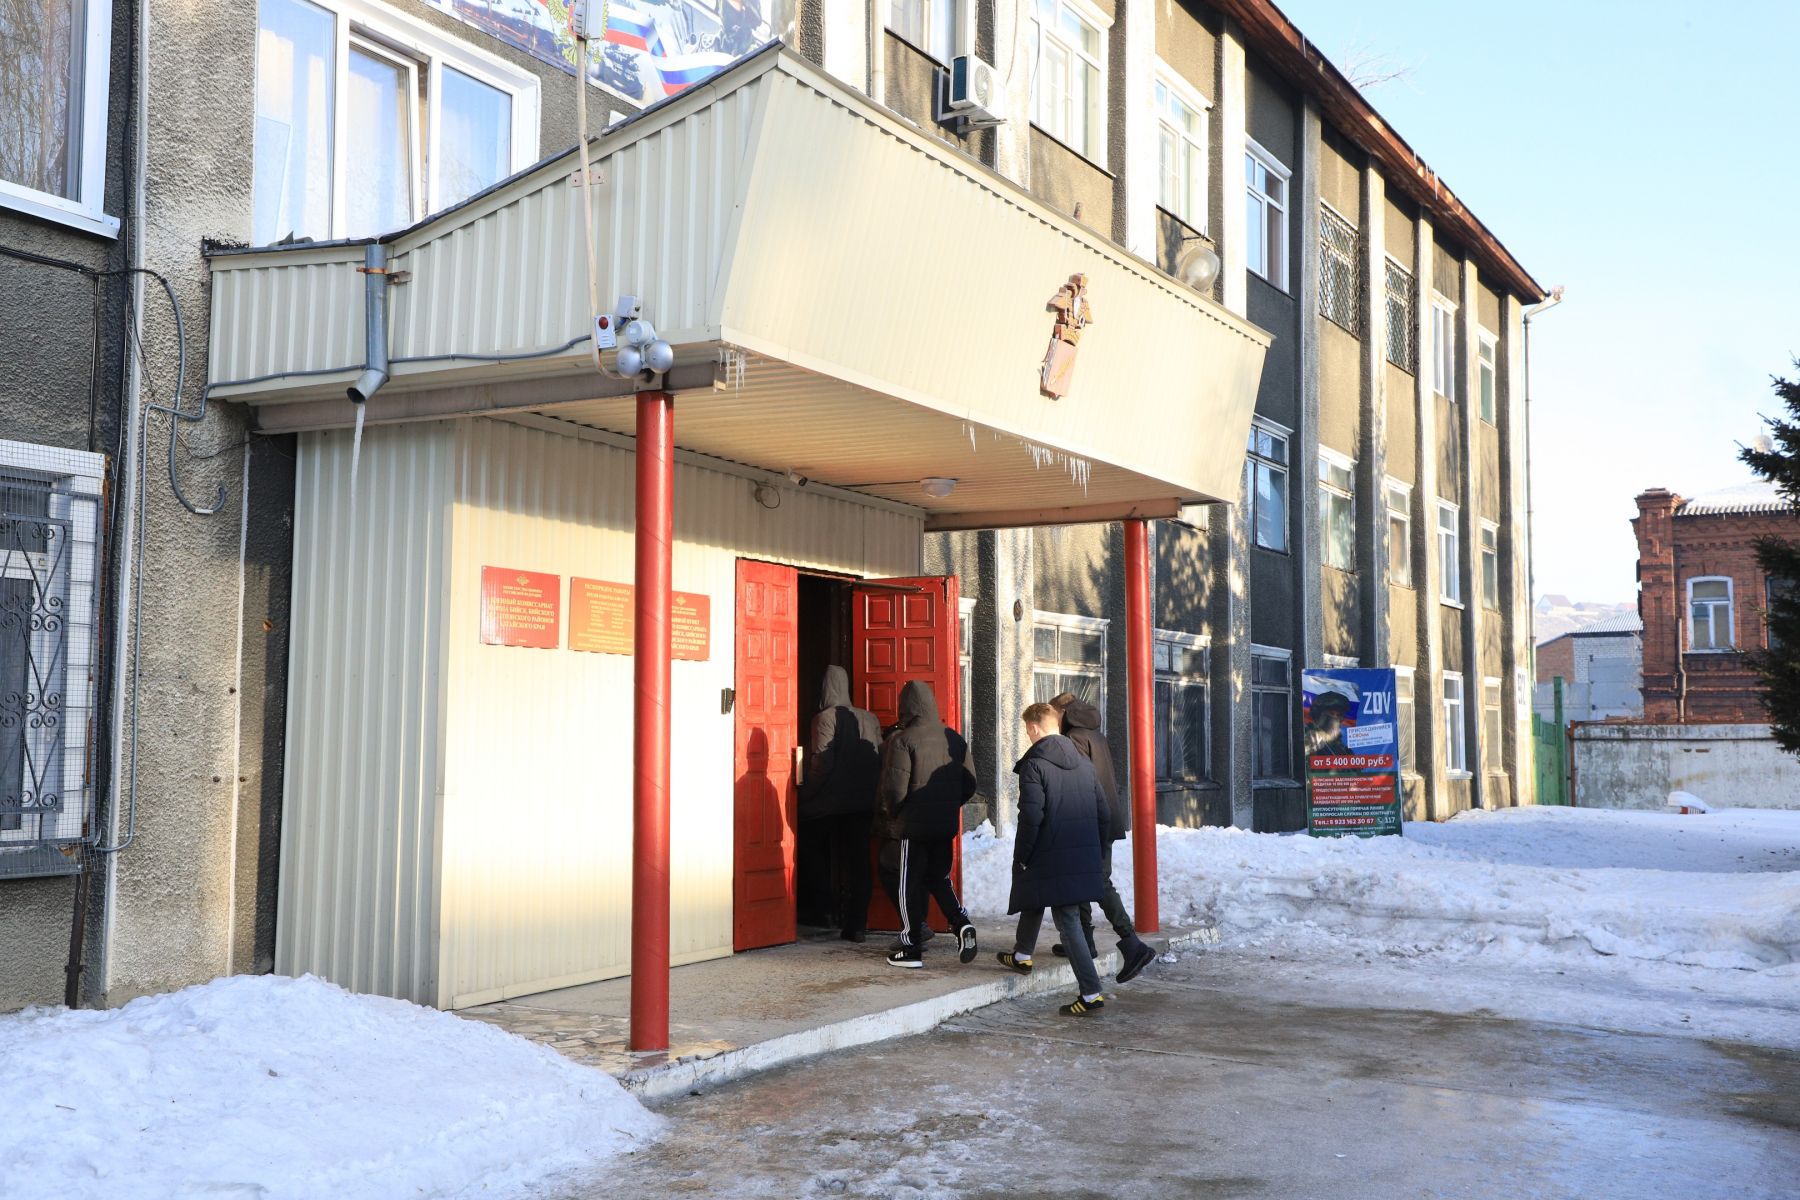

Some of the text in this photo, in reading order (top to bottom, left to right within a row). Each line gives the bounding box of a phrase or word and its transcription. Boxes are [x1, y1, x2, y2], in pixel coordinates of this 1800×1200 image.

[1362, 691, 1391, 715] ZOV
[1333, 758, 1348, 766] 400
[1350, 757, 1366, 765] 000
